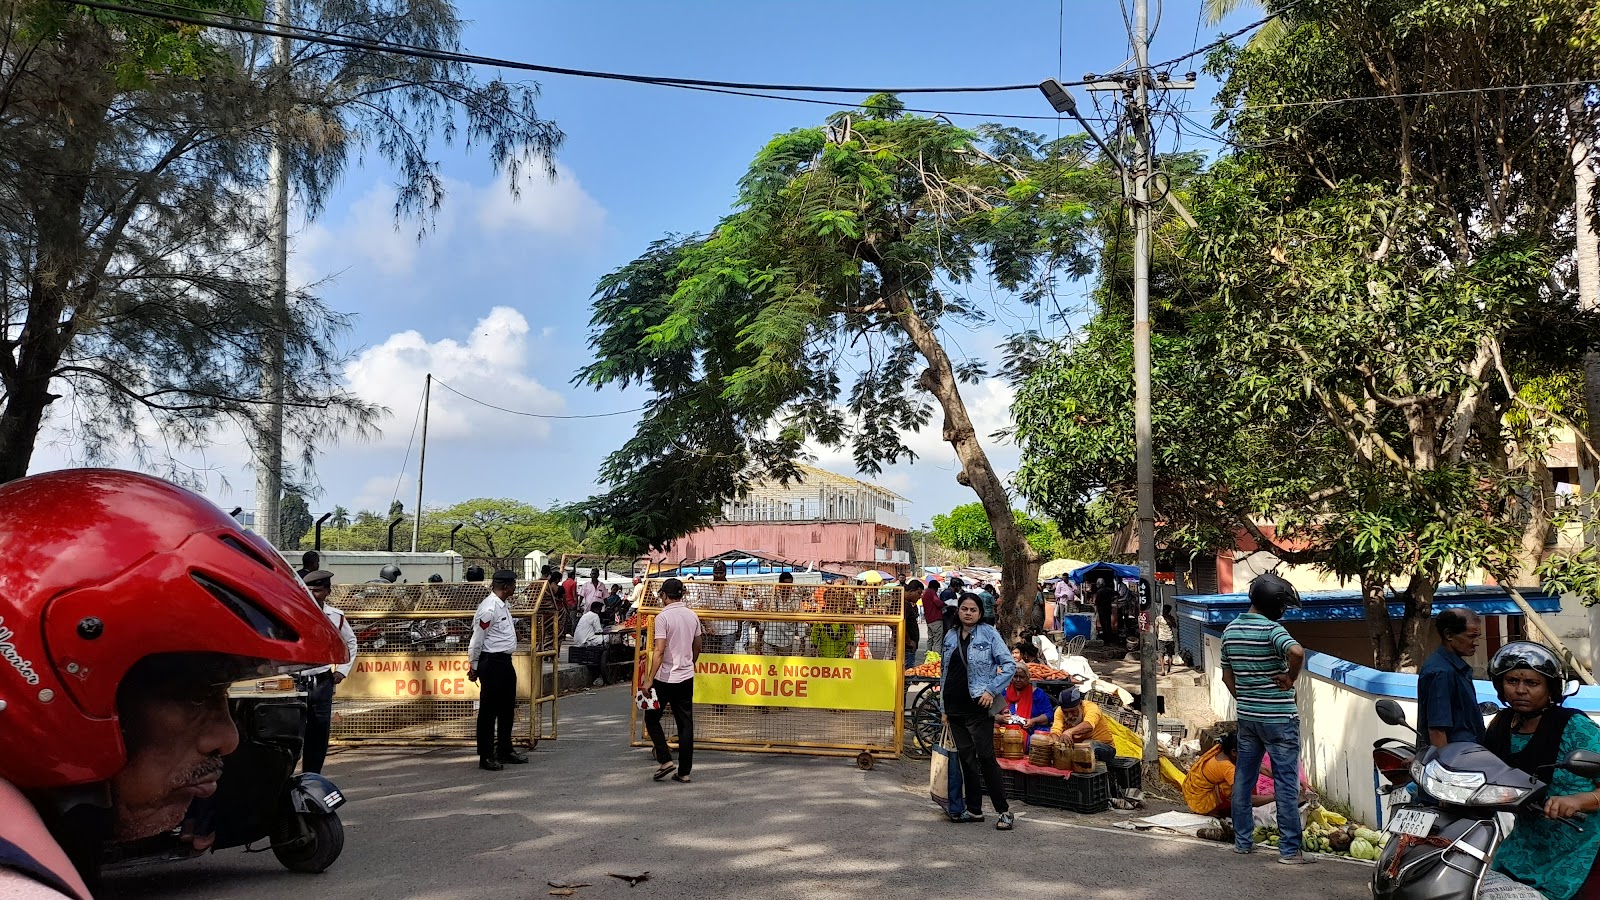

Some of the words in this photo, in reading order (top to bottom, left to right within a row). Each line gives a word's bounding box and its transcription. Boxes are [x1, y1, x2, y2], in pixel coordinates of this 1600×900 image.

[356, 660, 420, 673] ANDAMAN
[425, 660, 434, 671] &
[768, 664, 778, 676] &
[784, 665, 852, 679] NICOBAR
[395, 678, 465, 695] POLICE
[731, 678, 808, 697] POLICE
